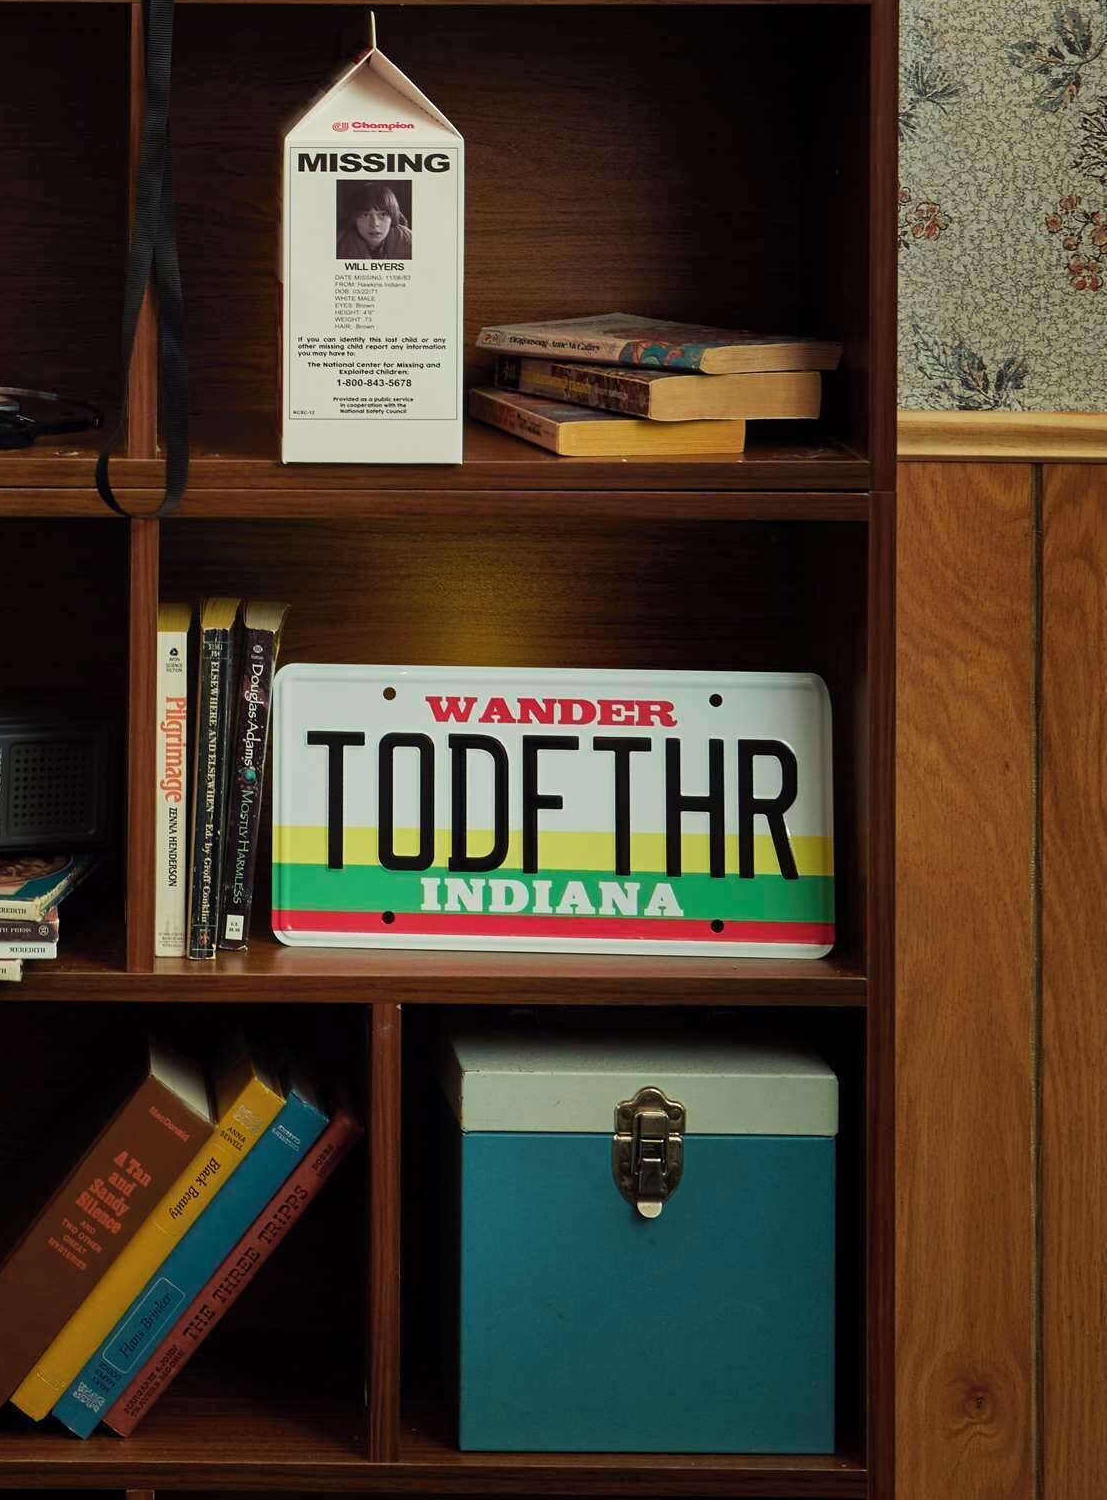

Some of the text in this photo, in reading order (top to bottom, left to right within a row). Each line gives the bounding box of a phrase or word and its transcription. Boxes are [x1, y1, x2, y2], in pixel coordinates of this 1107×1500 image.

[351, 121, 414, 132] Champion
[298, 153, 450, 173] MISSING
[344, 262, 405, 271] WILL BYERS
[336, 378, 413, 387] 1-800-843-5678
[397, 361, 424, 369] Missing
[242, 663, 265, 767] Douglas Adams
[425, 695, 678, 729] WANDER
[160, 696, 188, 803] Pilgrimage
[238, 789, 254, 836] MOSTLY
[307, 730, 800, 880] TODFTHR
[168, 807, 178, 887] ZENNA HENDERSON
[233, 839, 250, 905] HARMLESS
[420, 876, 685, 918] INDIANA
[148, 1105, 190, 1142] MacDonald
[219, 1130, 244, 1152] SEWELL
[226, 1126, 247, 1143] ANNA
[89, 1177, 130, 1217] Sandy
[107, 1171, 137, 1197] and
[169, 1156, 221, 1221] Black Beauty
[75, 1190, 123, 1235] Silence
[183, 1305, 216, 1341] THE
[211, 1247, 261, 1304] THREE
[257, 1184, 309, 1245] TRIPPS
